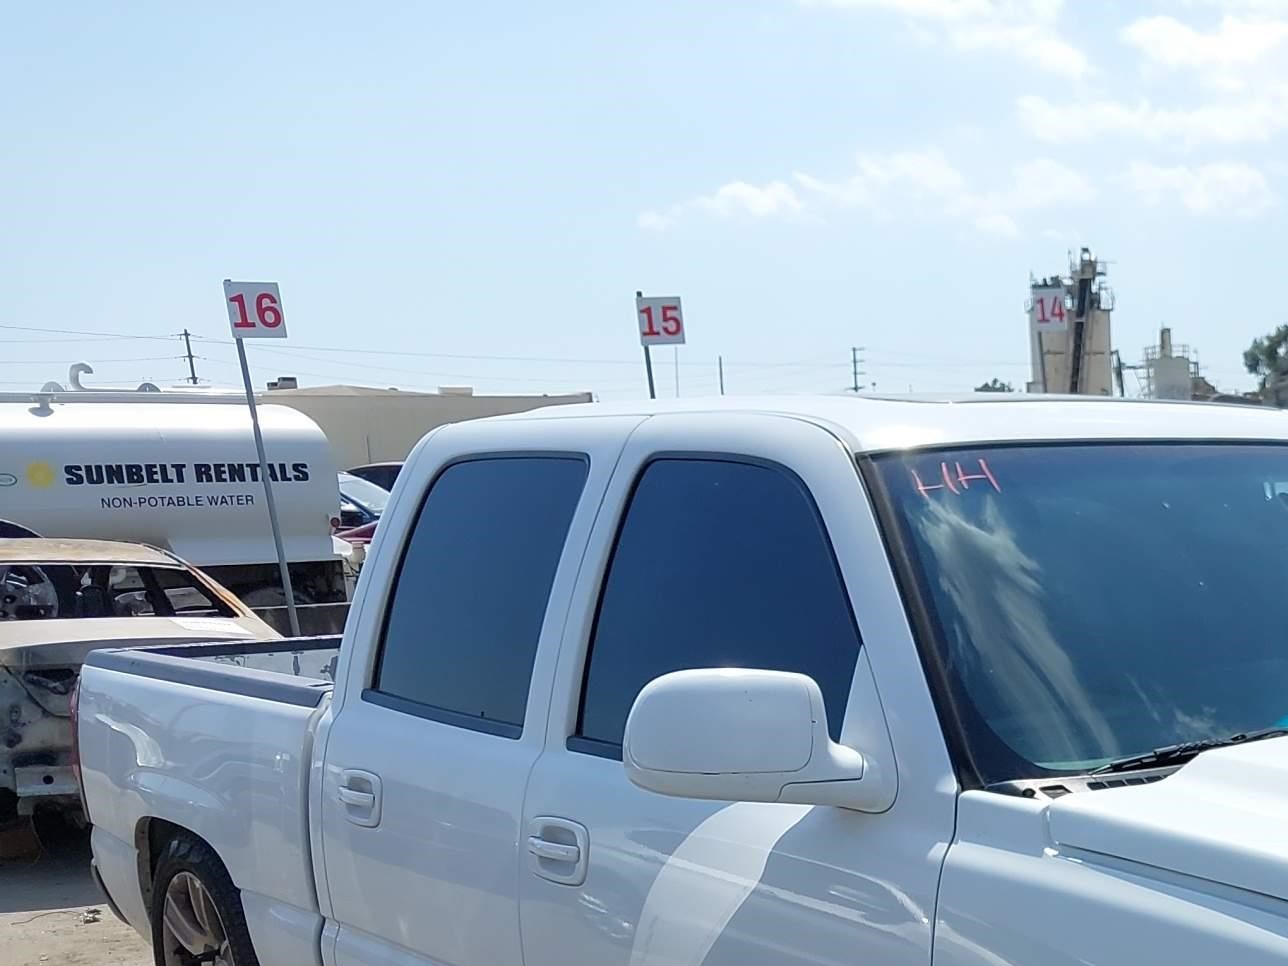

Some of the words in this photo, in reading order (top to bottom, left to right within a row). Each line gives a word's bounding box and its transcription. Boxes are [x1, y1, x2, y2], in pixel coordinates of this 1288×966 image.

[229, 293, 282, 328] 16
[640, 306, 681, 336] 15
[1036, 296, 1065, 322] 14
[64, 463, 186, 485] SUNBELT
[194, 462, 310, 483] RENTALS
[101, 496, 203, 509] NON-POTABLE
[207, 494, 254, 506] WATER
